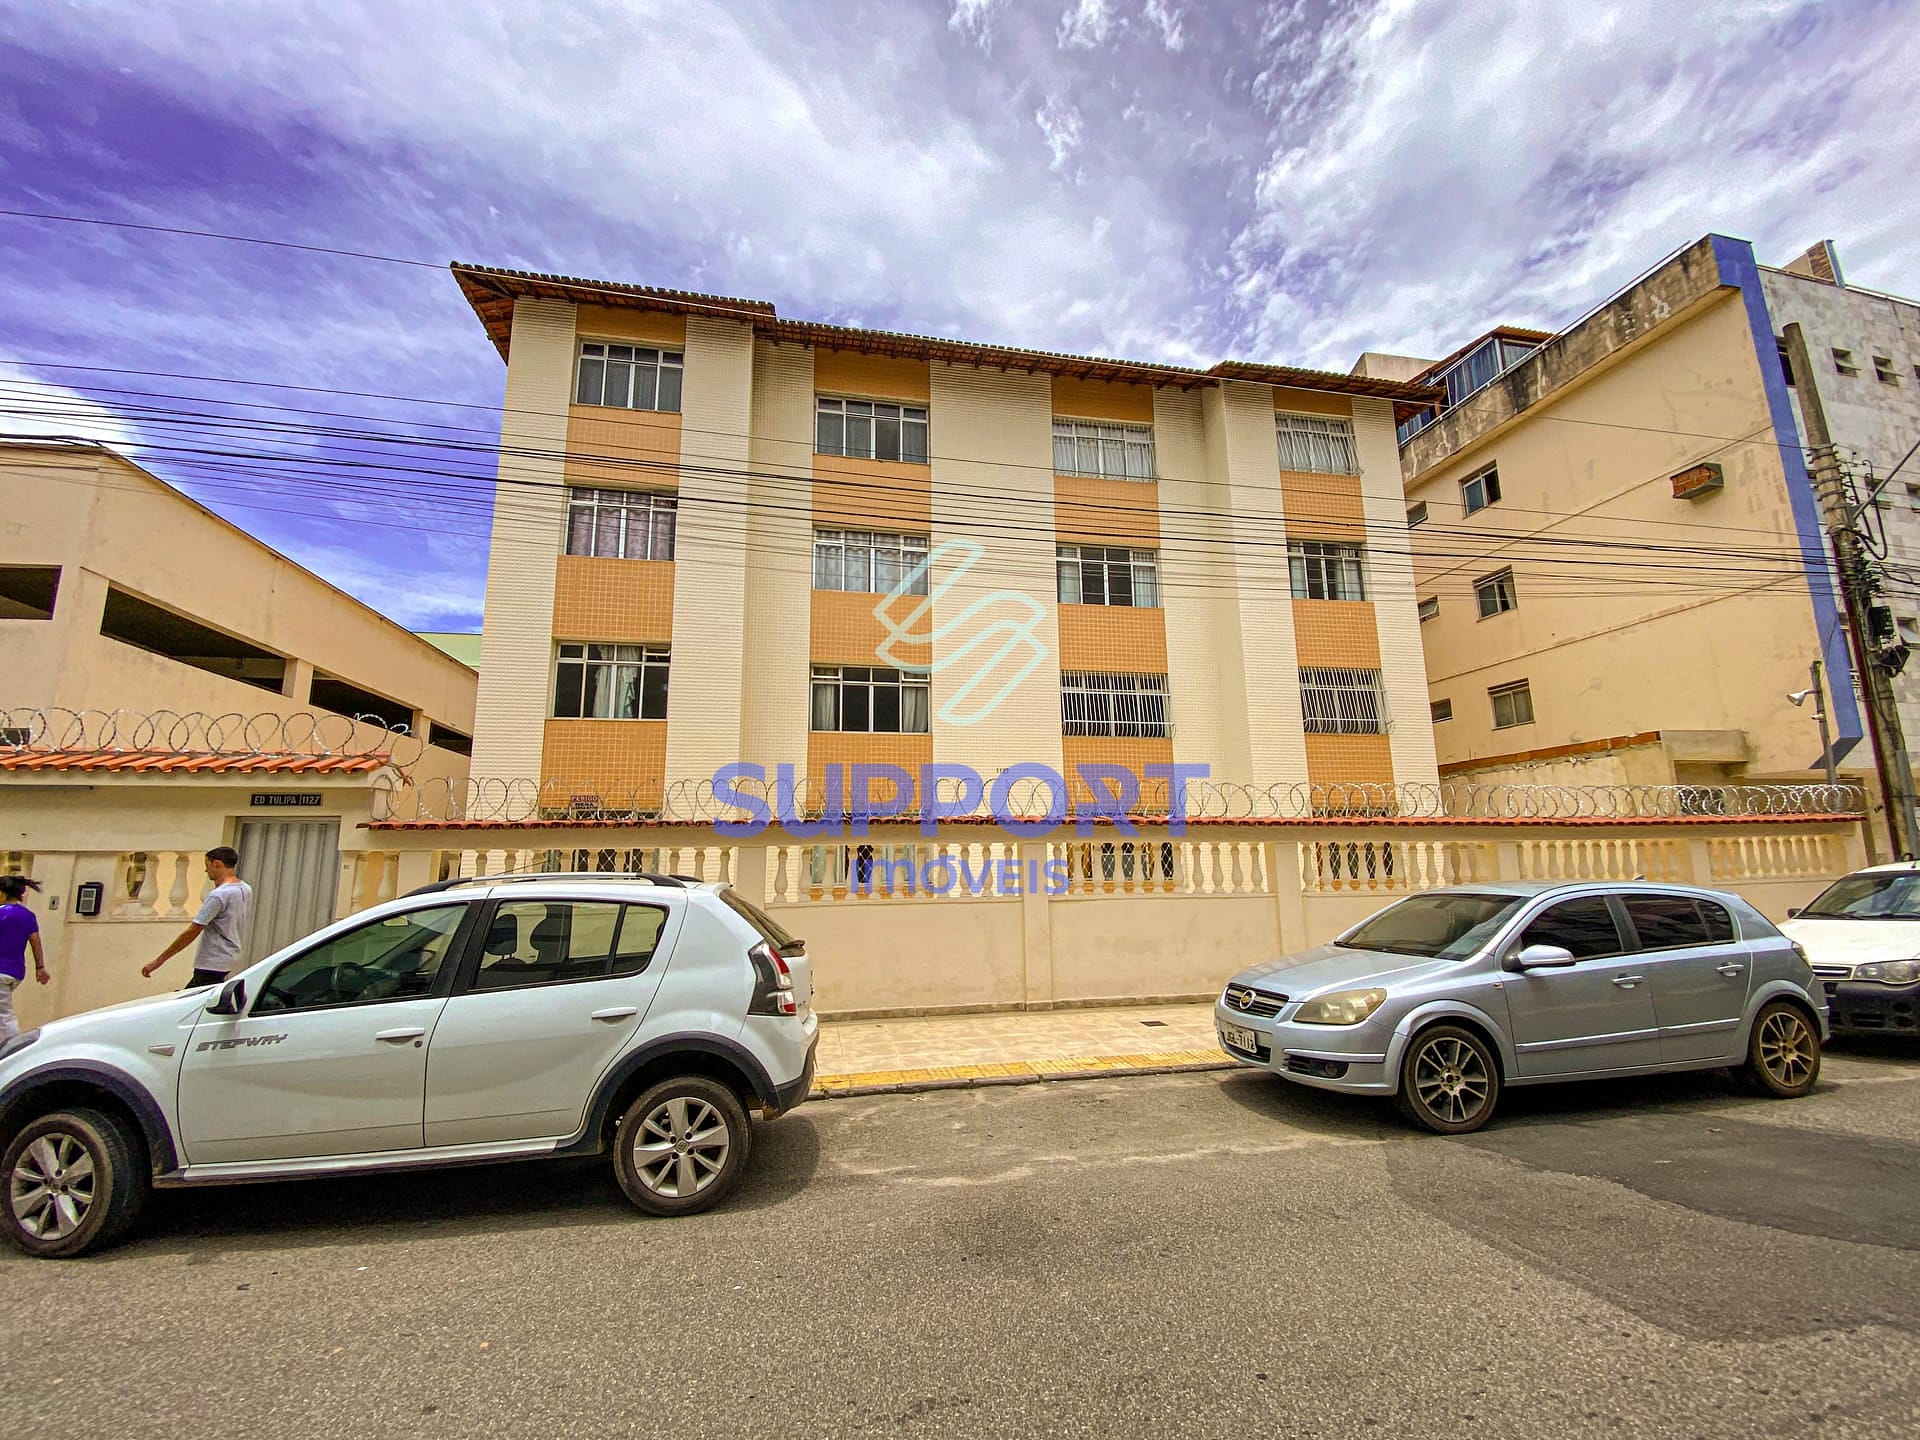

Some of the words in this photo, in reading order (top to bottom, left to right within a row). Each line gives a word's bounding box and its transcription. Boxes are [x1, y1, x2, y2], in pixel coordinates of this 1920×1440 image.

[254, 795, 266, 805] ED
[269, 795, 297, 805] TULIPA
[302, 795, 321, 805] 1127
[196, 1033, 289, 1051] STEPWAY
